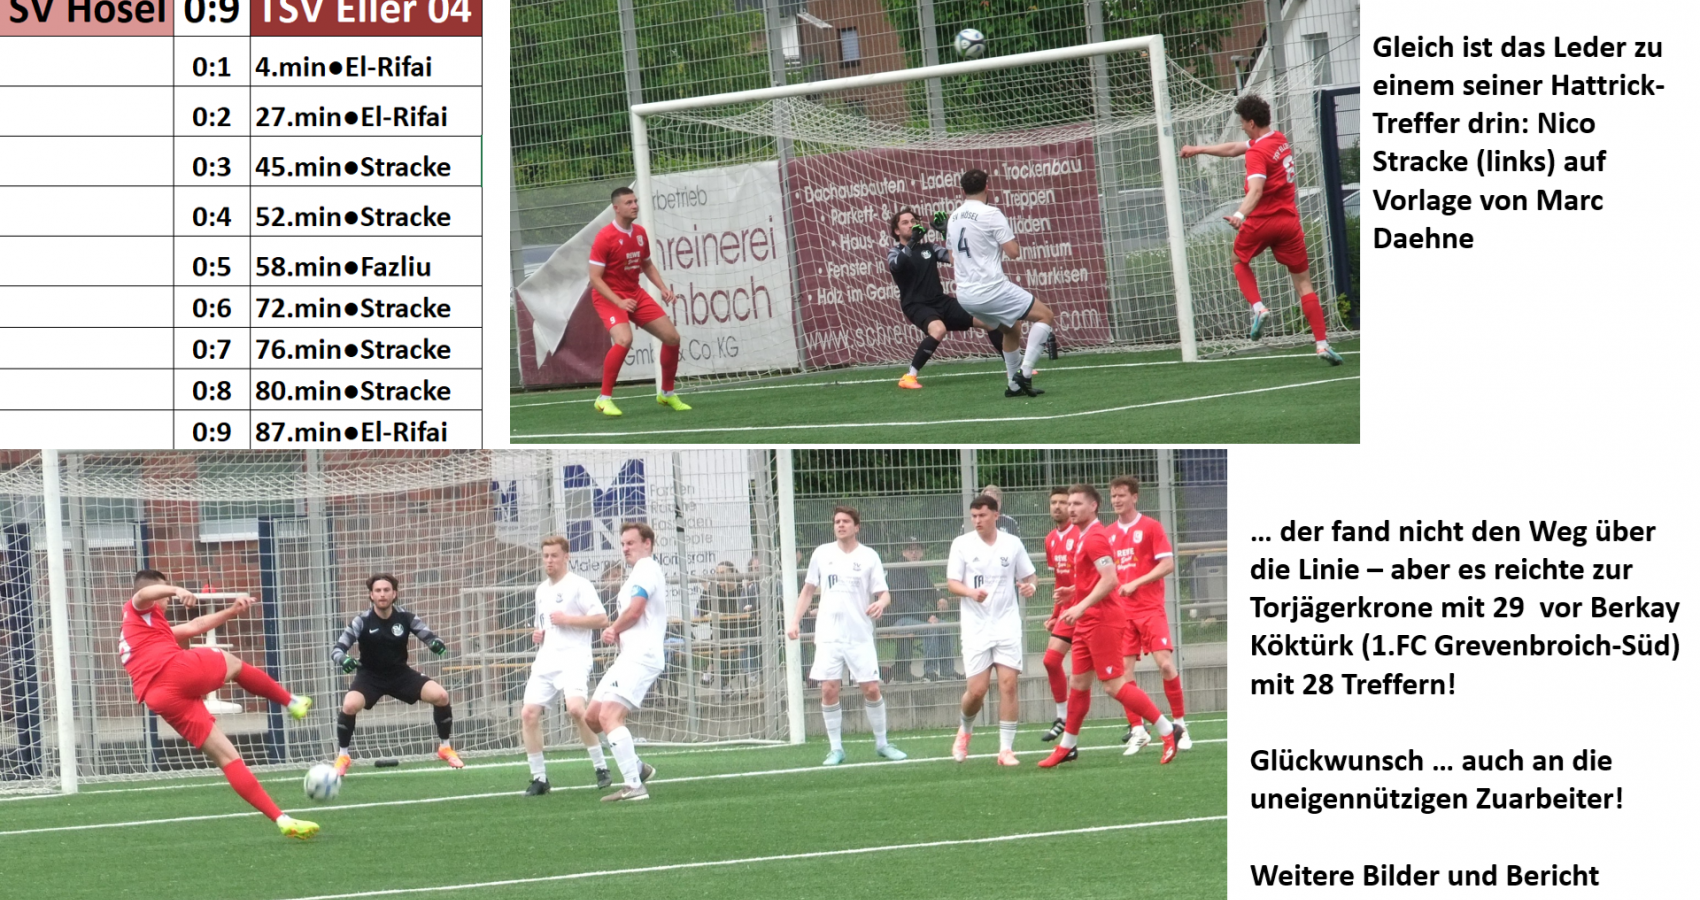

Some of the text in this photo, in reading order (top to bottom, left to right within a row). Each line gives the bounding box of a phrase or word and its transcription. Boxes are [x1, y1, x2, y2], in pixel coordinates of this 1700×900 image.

[1002, 158, 1082, 180] Trockenbau
[804, 168, 967, 203] Dachausbauten Laden
[652, 185, 707, 211] rbetrieb
[1003, 189, 1056, 211] Treppen
[831, 205, 878, 226] Parkett-
[882, 203, 891, 221] &
[840, 230, 875, 250] Haus-
[878, 230, 889, 248] &
[957, 226, 971, 258] 4
[828, 257, 885, 279] Fenster in
[1026, 267, 1089, 287] Markisen
[817, 282, 901, 305] Holz im Garte
[717, 336, 739, 359] KG
